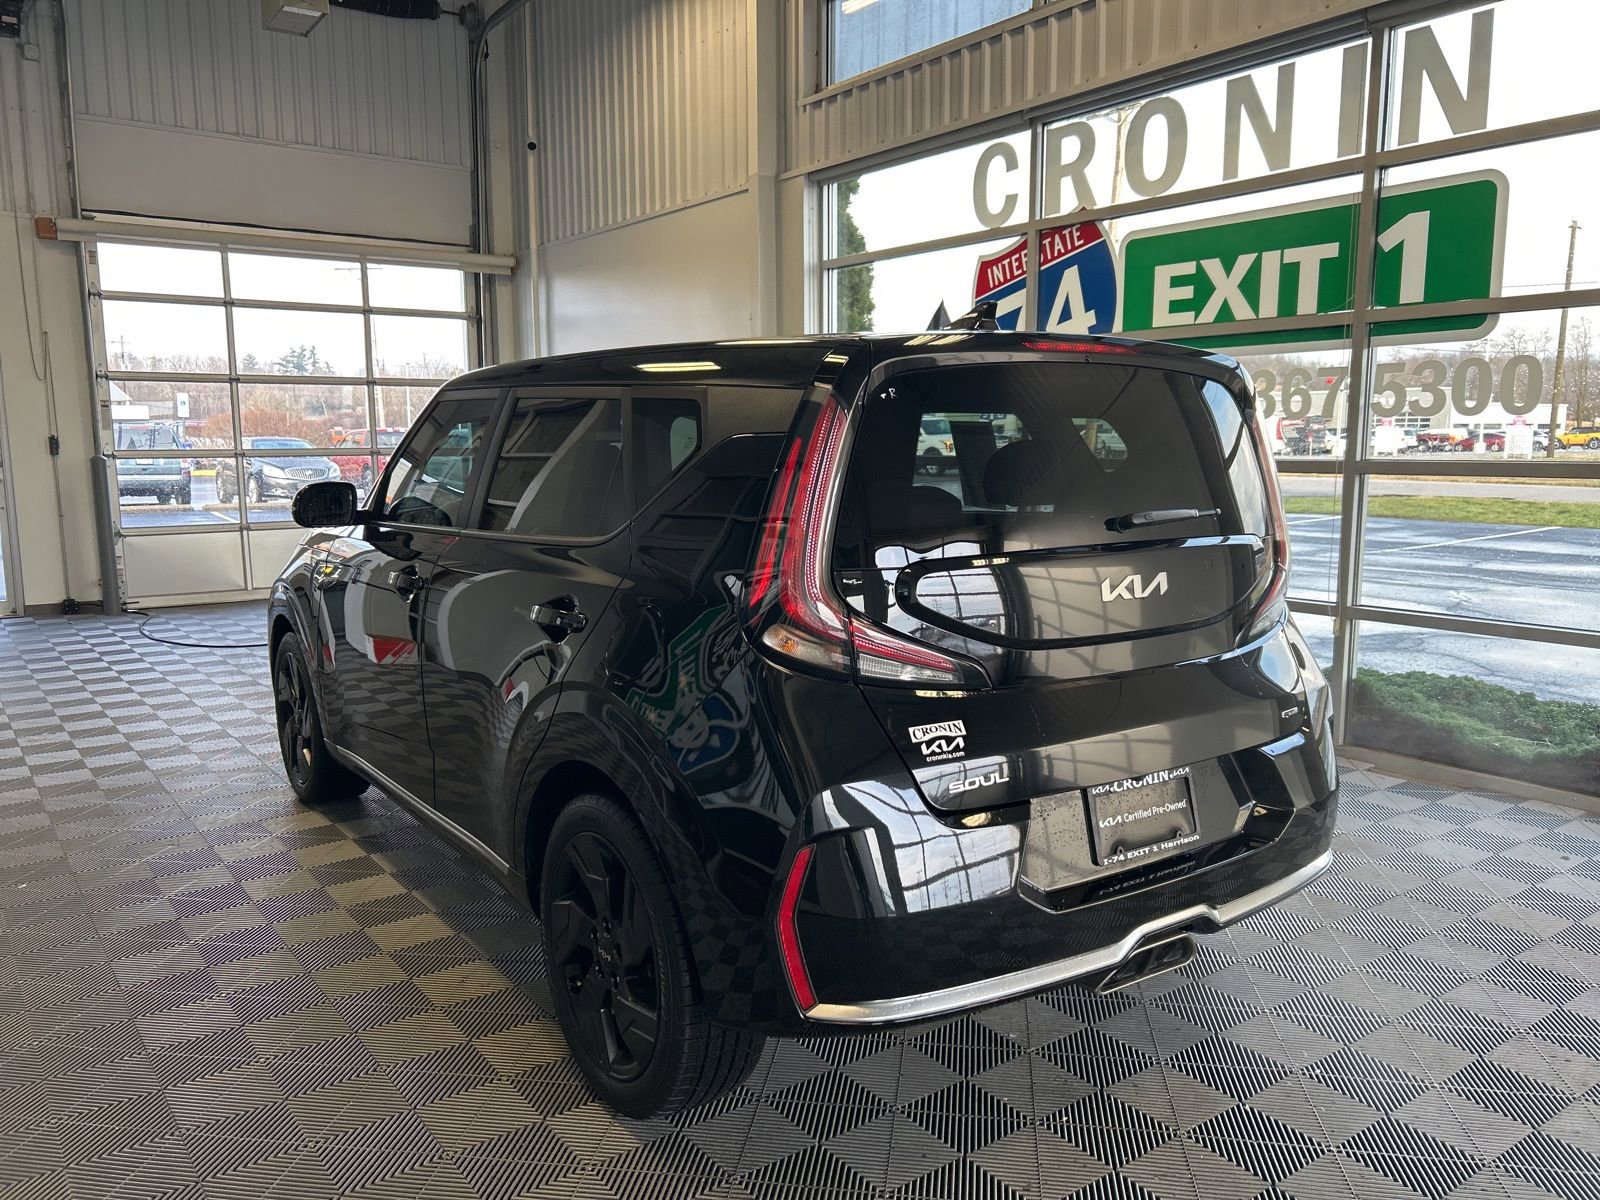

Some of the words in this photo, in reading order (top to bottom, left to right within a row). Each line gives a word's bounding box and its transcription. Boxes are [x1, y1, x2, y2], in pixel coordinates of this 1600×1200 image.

[973, 8, 1495, 229] CRONIN
[987, 224, 1085, 289] INTERTATE
[1152, 242, 1340, 328] EXIT
[1376, 210, 1430, 304] 1
[1101, 572, 1168, 602] KIA
[912, 722, 963, 740] CRONIN
[920, 737, 965, 755] KIA
[926, 751, 966, 762] croninkia.com
[949, 772, 1010, 794] SOUL
[1123, 808, 1152, 822] Certified
[1152, 798, 1187, 815] Pre-Owned
[1103, 854, 1125, 866] I-74
[1127, 847, 1151, 859] EXIT
[1161, 835, 1200, 850] Harrison
